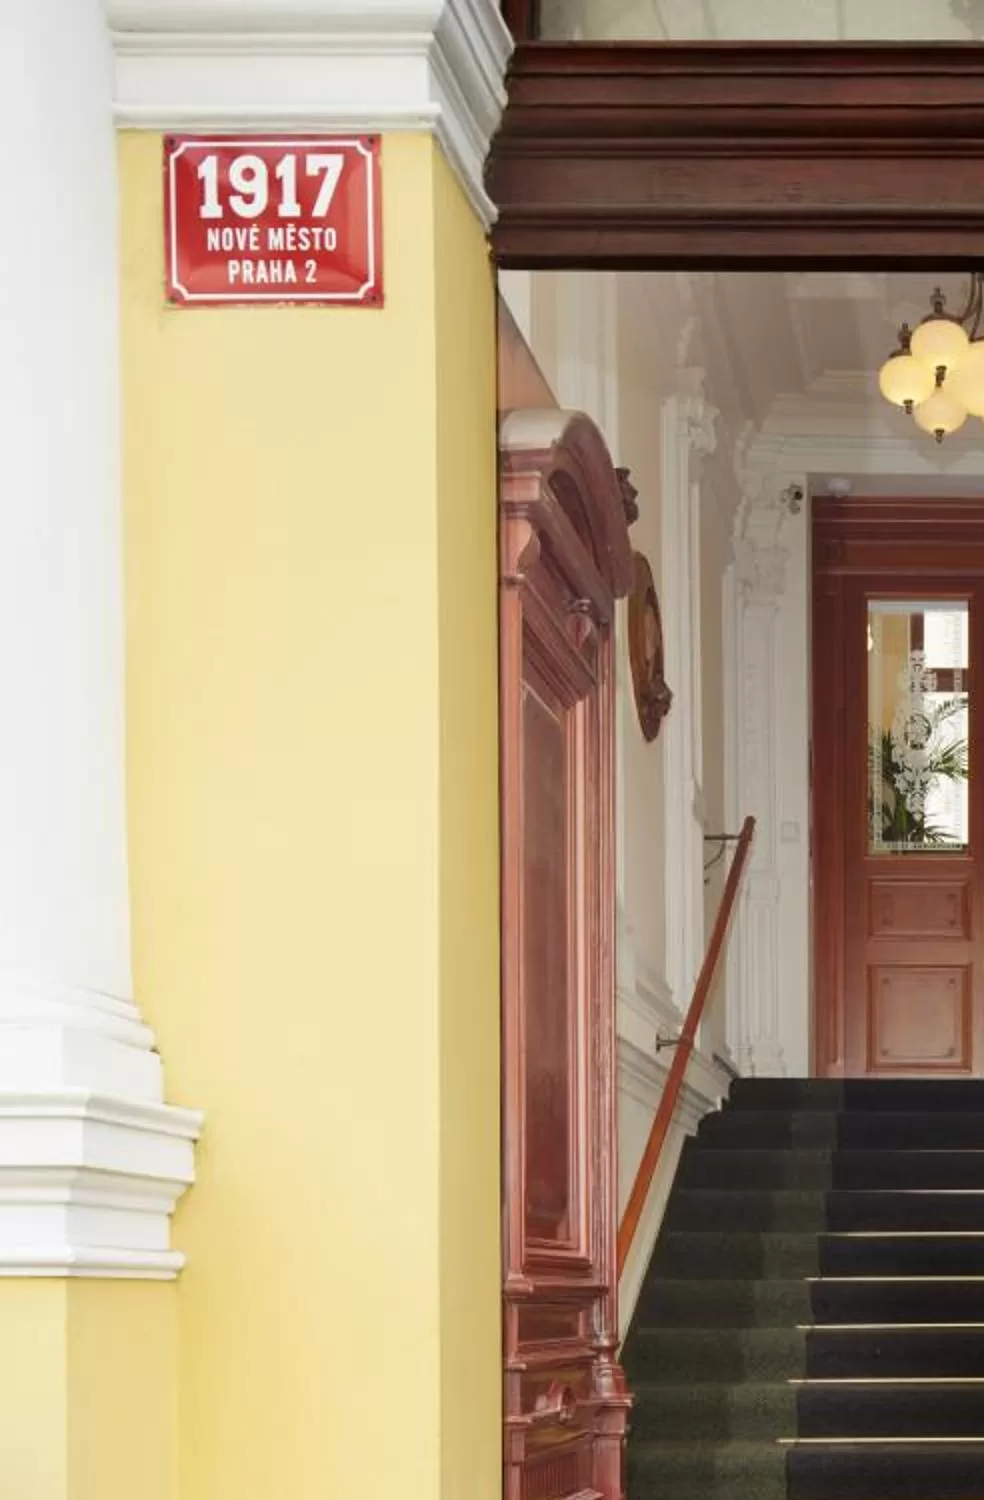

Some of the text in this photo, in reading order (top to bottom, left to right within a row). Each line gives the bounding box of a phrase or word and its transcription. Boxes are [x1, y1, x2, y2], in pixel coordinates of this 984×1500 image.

[197, 154, 345, 219] 1917
[207, 223, 337, 251] NOVÉ MĚSTO
[227, 259, 317, 285] PRAHA 2
